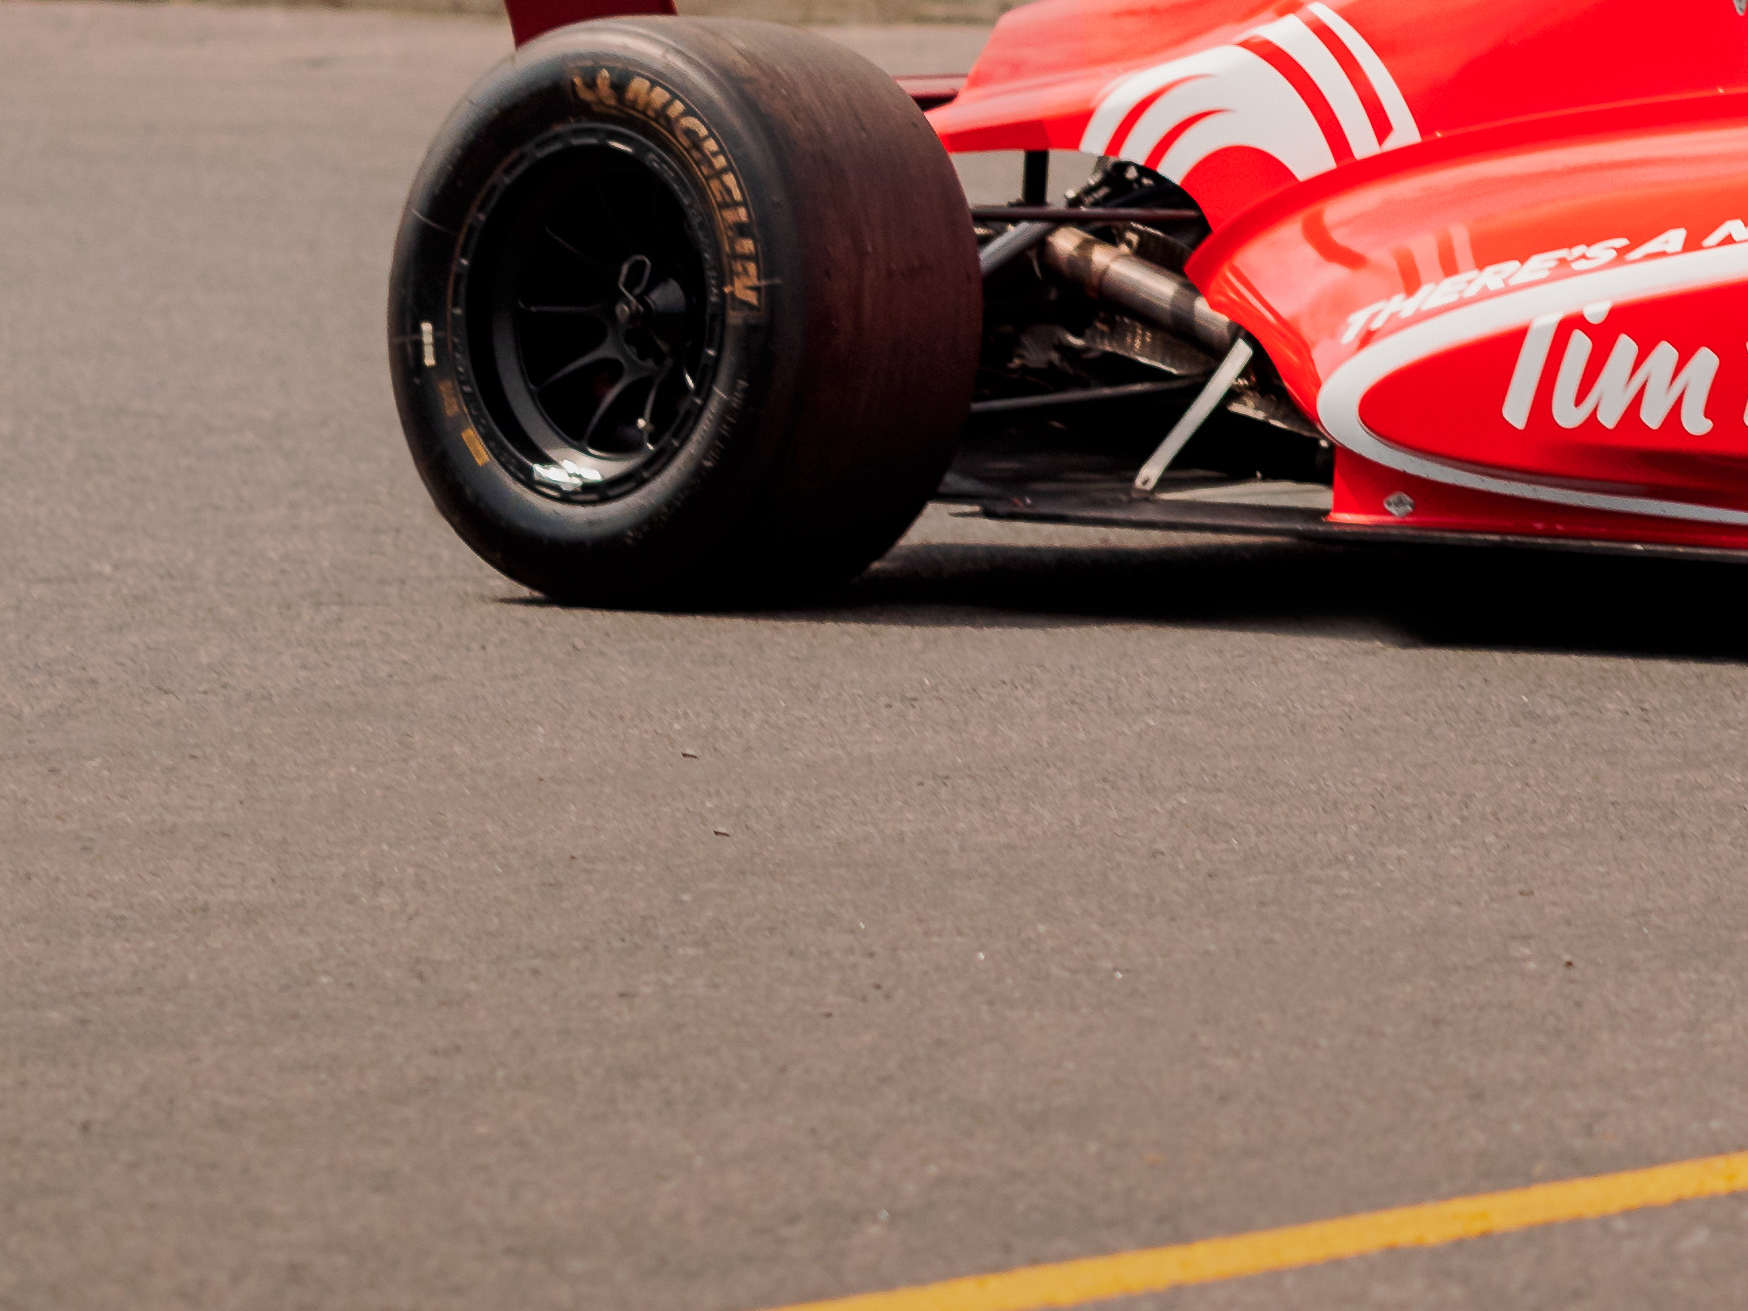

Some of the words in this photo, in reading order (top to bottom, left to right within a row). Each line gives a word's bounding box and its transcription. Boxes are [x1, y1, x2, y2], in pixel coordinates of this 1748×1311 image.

[1341, 238, 1630, 345] THERE'S
[1626, 228, 1687, 261] A
[1502, 297, 1720, 436] Tim
